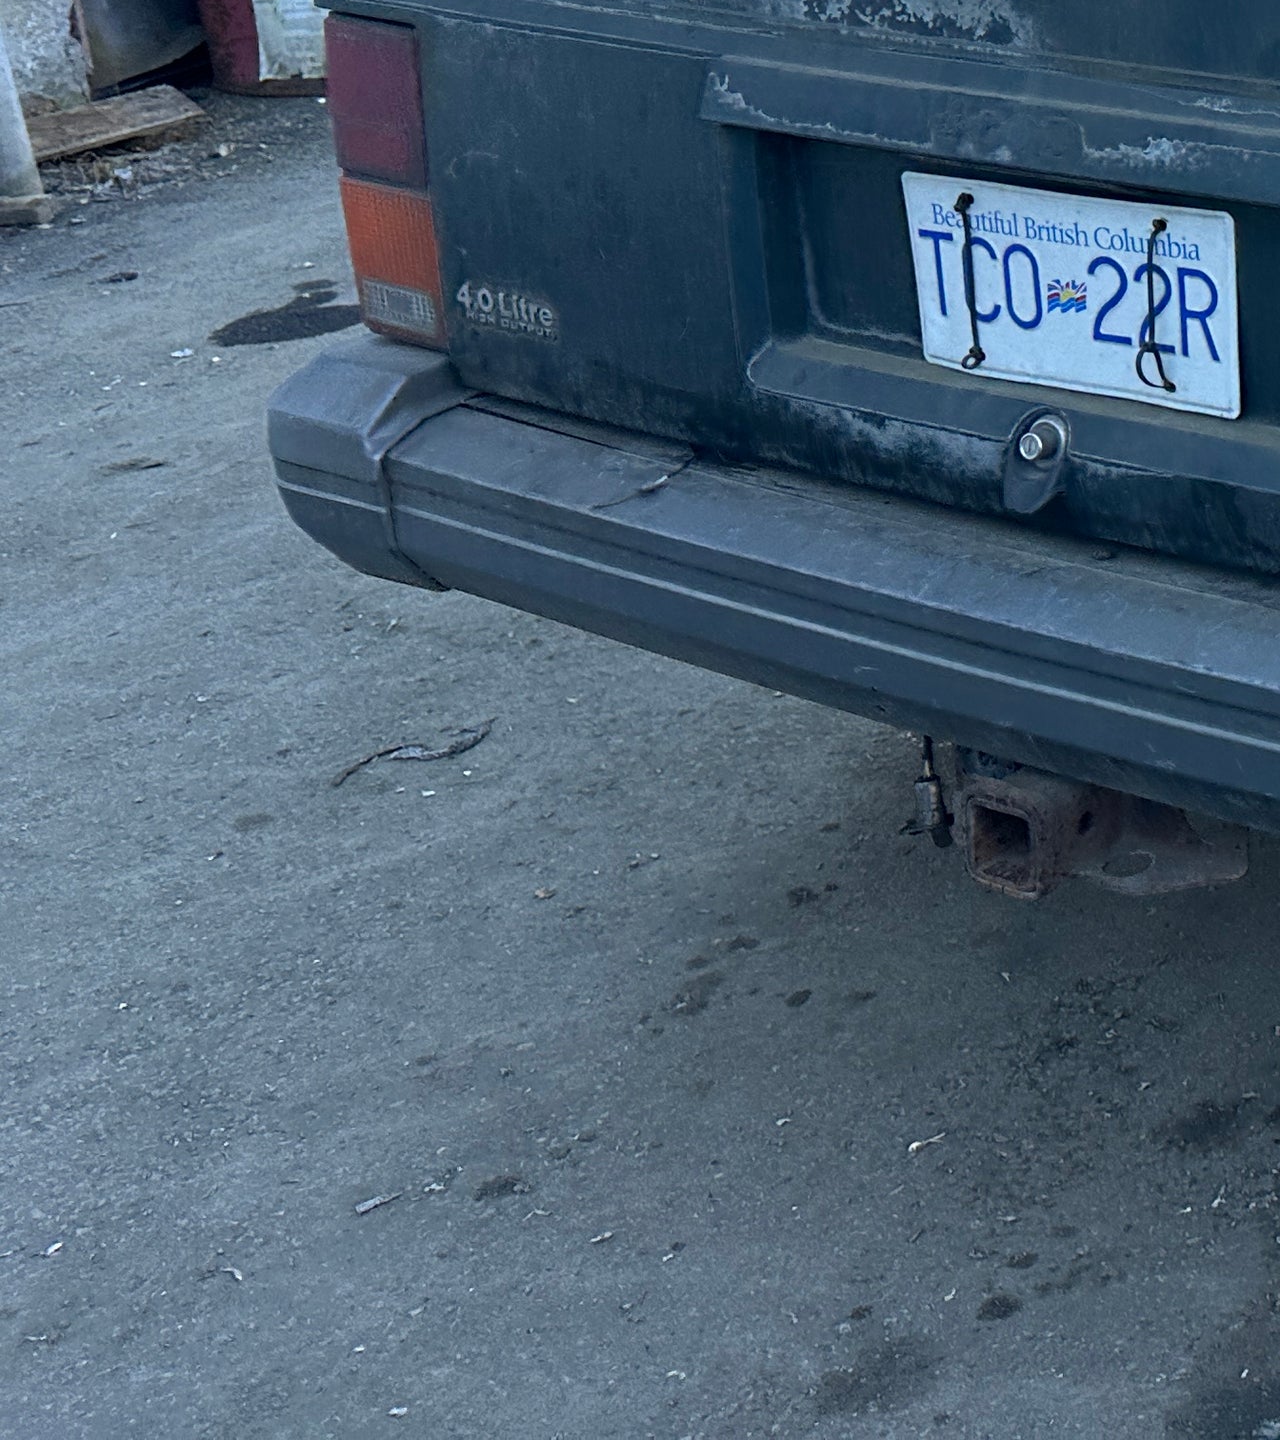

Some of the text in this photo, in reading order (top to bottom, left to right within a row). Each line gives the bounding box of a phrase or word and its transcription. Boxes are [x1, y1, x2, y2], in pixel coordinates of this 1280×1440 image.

[931, 203, 1201, 261] Beautiful British Columbia
[498, 292, 553, 327] Litre
[1087, 256, 1221, 362] 22R
